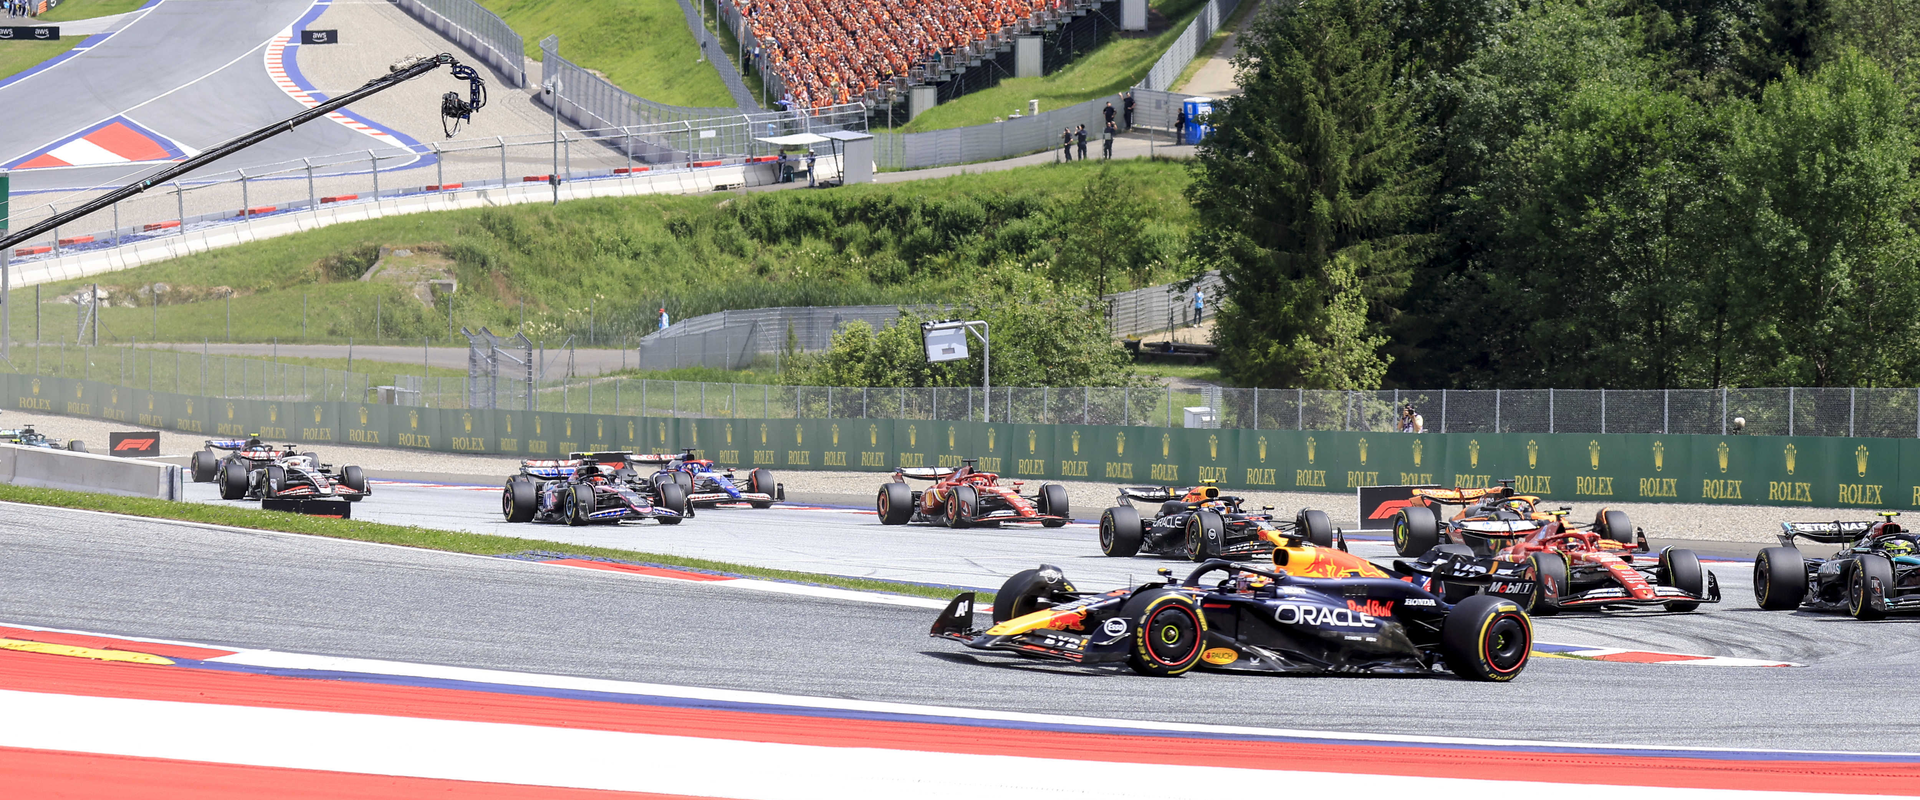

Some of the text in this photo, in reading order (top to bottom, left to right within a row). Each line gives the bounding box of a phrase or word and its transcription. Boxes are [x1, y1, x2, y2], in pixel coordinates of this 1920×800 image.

[34, 28, 50, 36] aws
[19, 397, 51, 410] ROLEX
[67, 402, 90, 415] ROLEX
[103, 407, 125, 420] ROLEX
[139, 413, 163, 427] ROLEX
[177, 418, 202, 432] ROLEX
[217, 423, 243, 435] ROLEX
[260, 426, 286, 439] ROLEX
[303, 428, 331, 440] ROLEX
[349, 429, 379, 443] ROLEX
[399, 433, 431, 448] ROLEX
[452, 437, 485, 450] ROLEX
[501, 438, 518, 451] ROLEX
[528, 440, 547, 453] ROLEX
[719, 450, 739, 464] ROLEX
[753, 450, 774, 464] ROLEX
[788, 451, 810, 465] ROLEX
[824, 451, 846, 466] ROLEX
[861, 452, 884, 466] ROLEX
[900, 453, 924, 467] ROLEX
[979, 457, 1001, 472] ROLEX
[1018, 459, 1044, 475] ROLEX
[1062, 460, 1088, 476] ROLEX
[1106, 462, 1133, 479] ROLEX
[1151, 464, 1178, 481] ROLEX
[1199, 466, 1227, 483] ROLEX
[1246, 468, 1276, 485] ROLEX
[1296, 470, 1326, 486] ROLEX
[1347, 471, 1379, 487] ROLEX
[1514, 475, 1551, 493] ROLEX
[1576, 476, 1613, 495] ROLEX
[1639, 478, 1677, 497] ROLEX
[1702, 479, 1742, 499] ROLEX
[1768, 481, 1812, 502] ROLEX
[1839, 483, 1883, 504] ROLEX
[1796, 522, 1868, 532] PETRONAS
[1488, 581, 1521, 594] Mobil
[1404, 598, 1437, 607] HONDA
[1274, 604, 1376, 628] ORACLE
[1107, 622, 1124, 631] Esso
[1211, 650, 1234, 660] RAUCH
